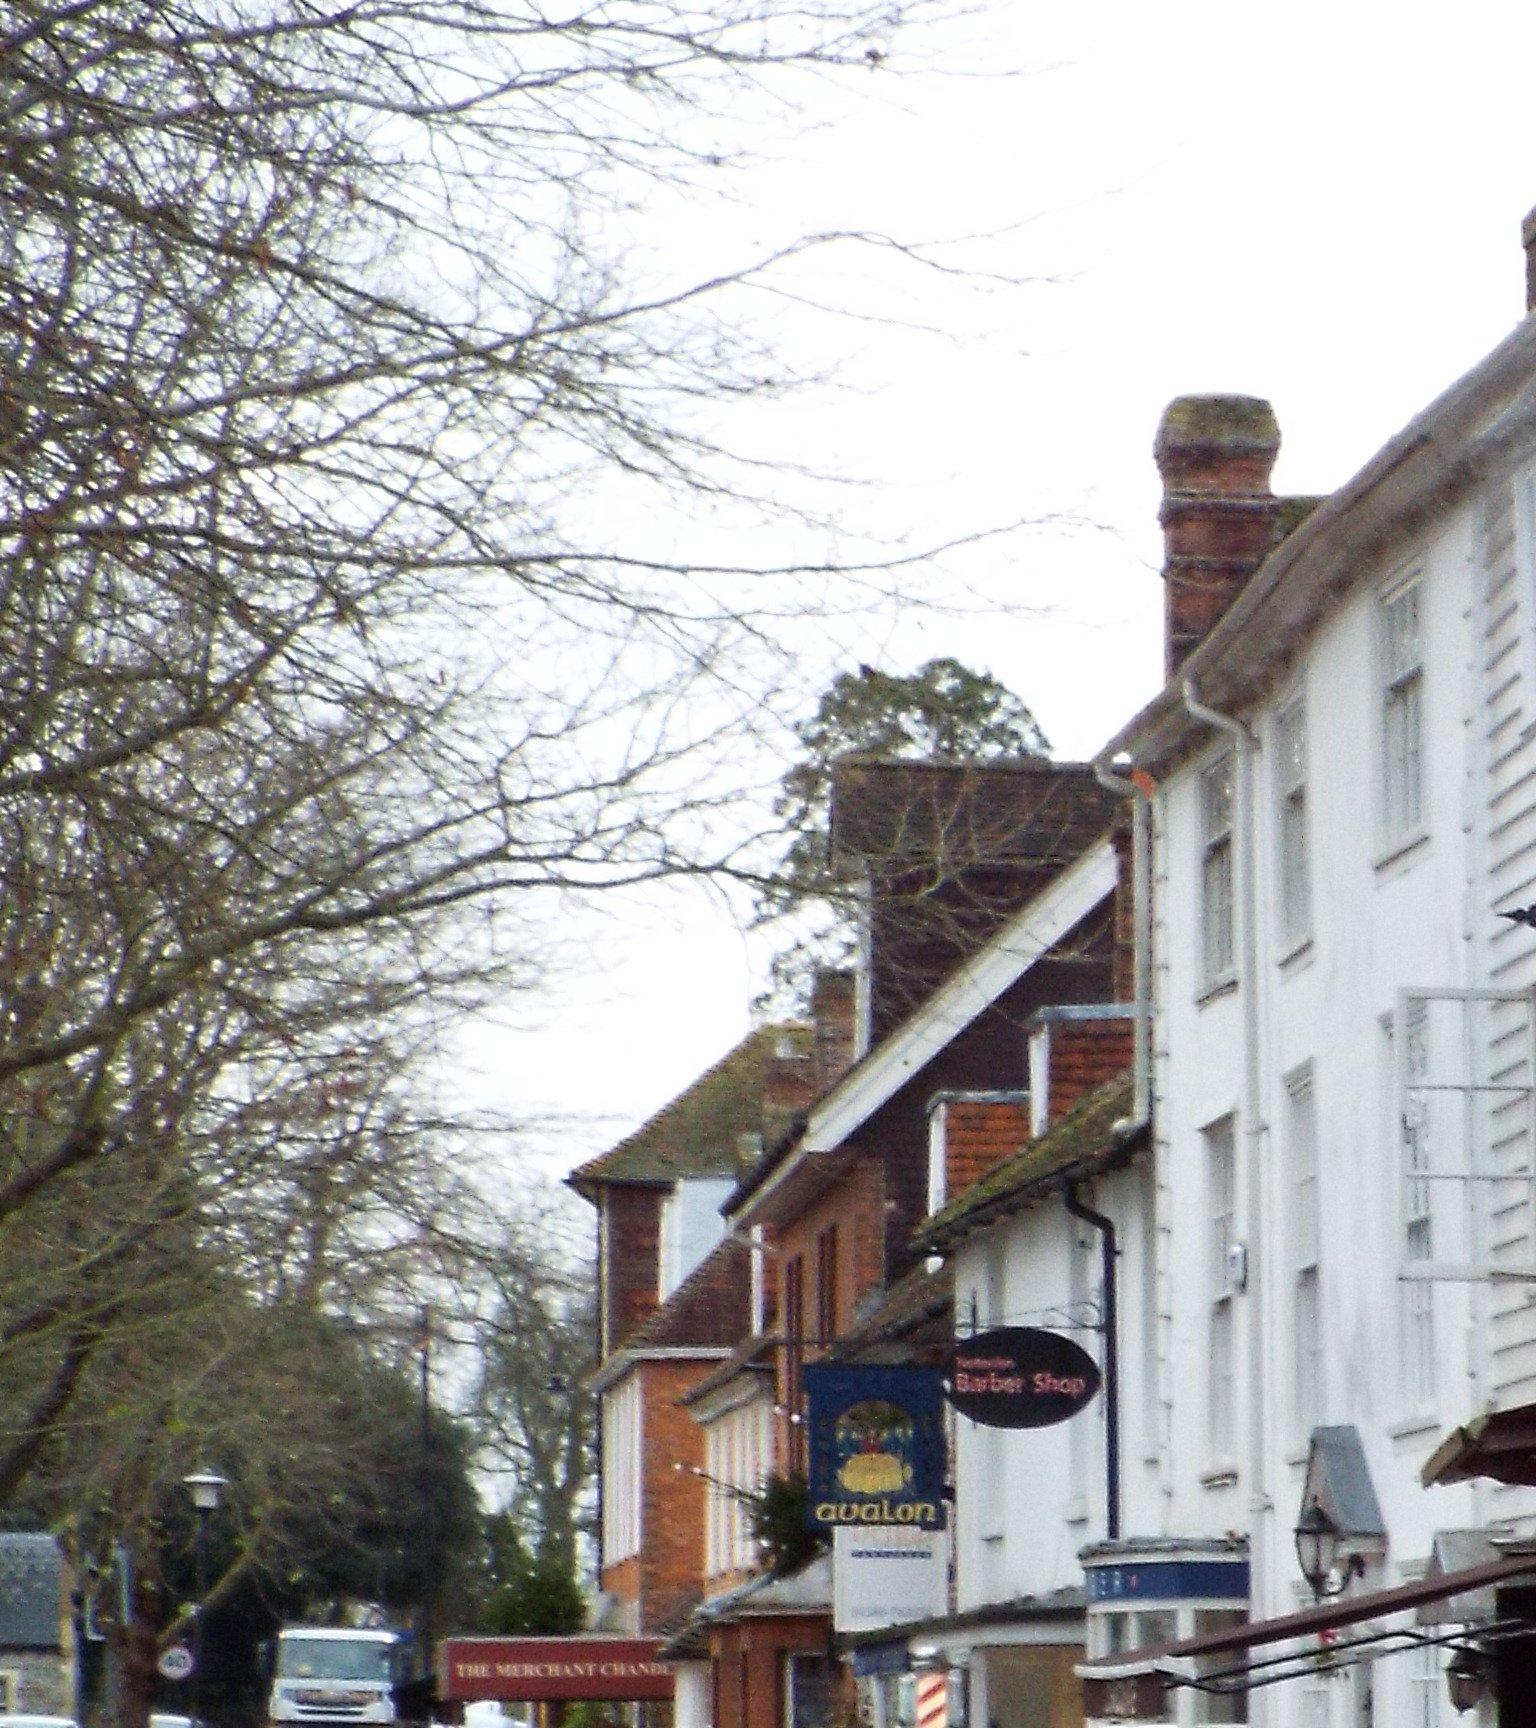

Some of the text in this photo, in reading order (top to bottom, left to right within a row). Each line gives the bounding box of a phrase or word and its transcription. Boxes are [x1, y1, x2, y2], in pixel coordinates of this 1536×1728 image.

[1033, 1372, 1086, 1398] Shop
[456, 1664, 490, 1678] THE
[497, 1663, 598, 1678] MERCHANT
